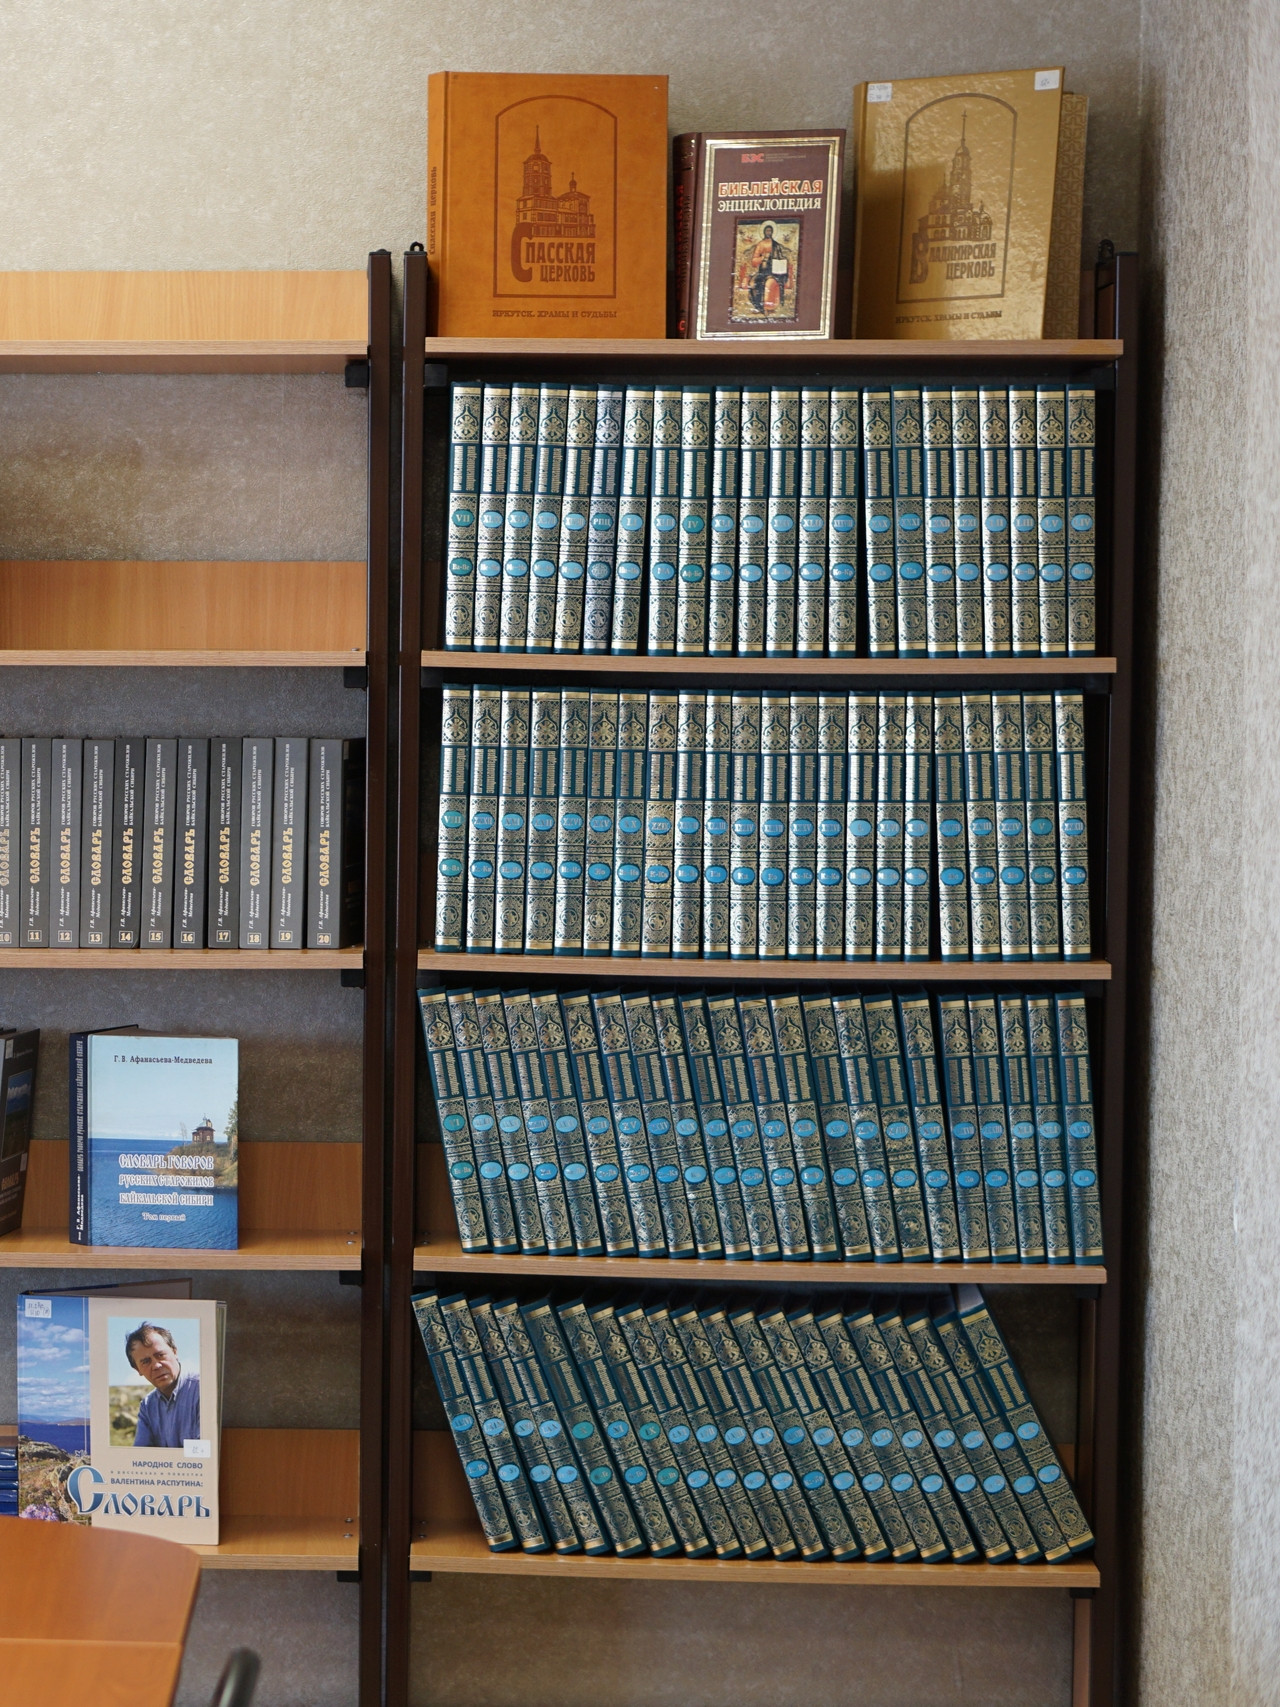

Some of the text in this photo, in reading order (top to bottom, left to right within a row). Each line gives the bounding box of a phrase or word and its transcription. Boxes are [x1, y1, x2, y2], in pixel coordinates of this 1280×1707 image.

[741, 153, 764, 163] БЭС
[718, 178, 823, 197] БИБЛЕЙСКАЯ
[717, 198, 822, 213] ЭНЦИКЛОПЕДИЯ
[511, 222, 596, 282] СПАССКАЯ
[540, 265, 596, 283] ЦЕРКОВЬ
[946, 261, 995, 280] ЦЕРКОВЬ
[492, 310, 535, 318] ИРКУТСК.
[581, 311, 617, 319] СУДЬБЫ
[456, 514, 470, 522] VII
[593, 518, 611, 527] РПЦ
[0, 828, 9, 887] СЛОВАРЬ
[29, 826, 41, 885] СЛОВАРЬ
[60, 826, 72, 885] СЛОВАРЬ
[91, 828, 103, 886] СЛОВАРЬ
[121, 827, 134, 885] СЛОВАРЬ
[152, 826, 165, 885] СЛОВАРЬ
[184, 827, 196, 886] СЛОВАРЬ
[218, 826, 231, 885] СЛОВАРЬ
[250, 828, 262, 887] СЛОВАРЬ
[282, 826, 294, 885] СЛОВАРЬ
[319, 829, 331, 888] СЛОВАРЬ
[0, 933, 11, 942] 10
[29, 931, 40, 941] 11
[59, 931, 71, 941] 12
[90, 933, 102, 942] 13
[120, 931, 132, 941] 14
[151, 931, 162, 941] 15
[182, 933, 194, 942] 16
[218, 931, 229, 941] 17
[249, 933, 261, 943] 18
[280, 931, 292, 941] 19
[318, 934, 331, 943] 20
[114, 1055, 213, 1065] Г. В. Афанасьева-Медведева
[119, 1153, 214, 1170] СЛОВАРЬ ГОВОРОВ
[118, 1174, 215, 1188] РУССКИХ СТАРОЖИЛОВ
[119, 1191, 214, 1206] БАЙКАЛЬСКОЙ СИБИРИ
[132, 1461, 203, 1469] НАРОДНОЕ СЛОВО
[110, 1478, 204, 1487] ВАЛЕНТИНА РАСПУТИНА:
